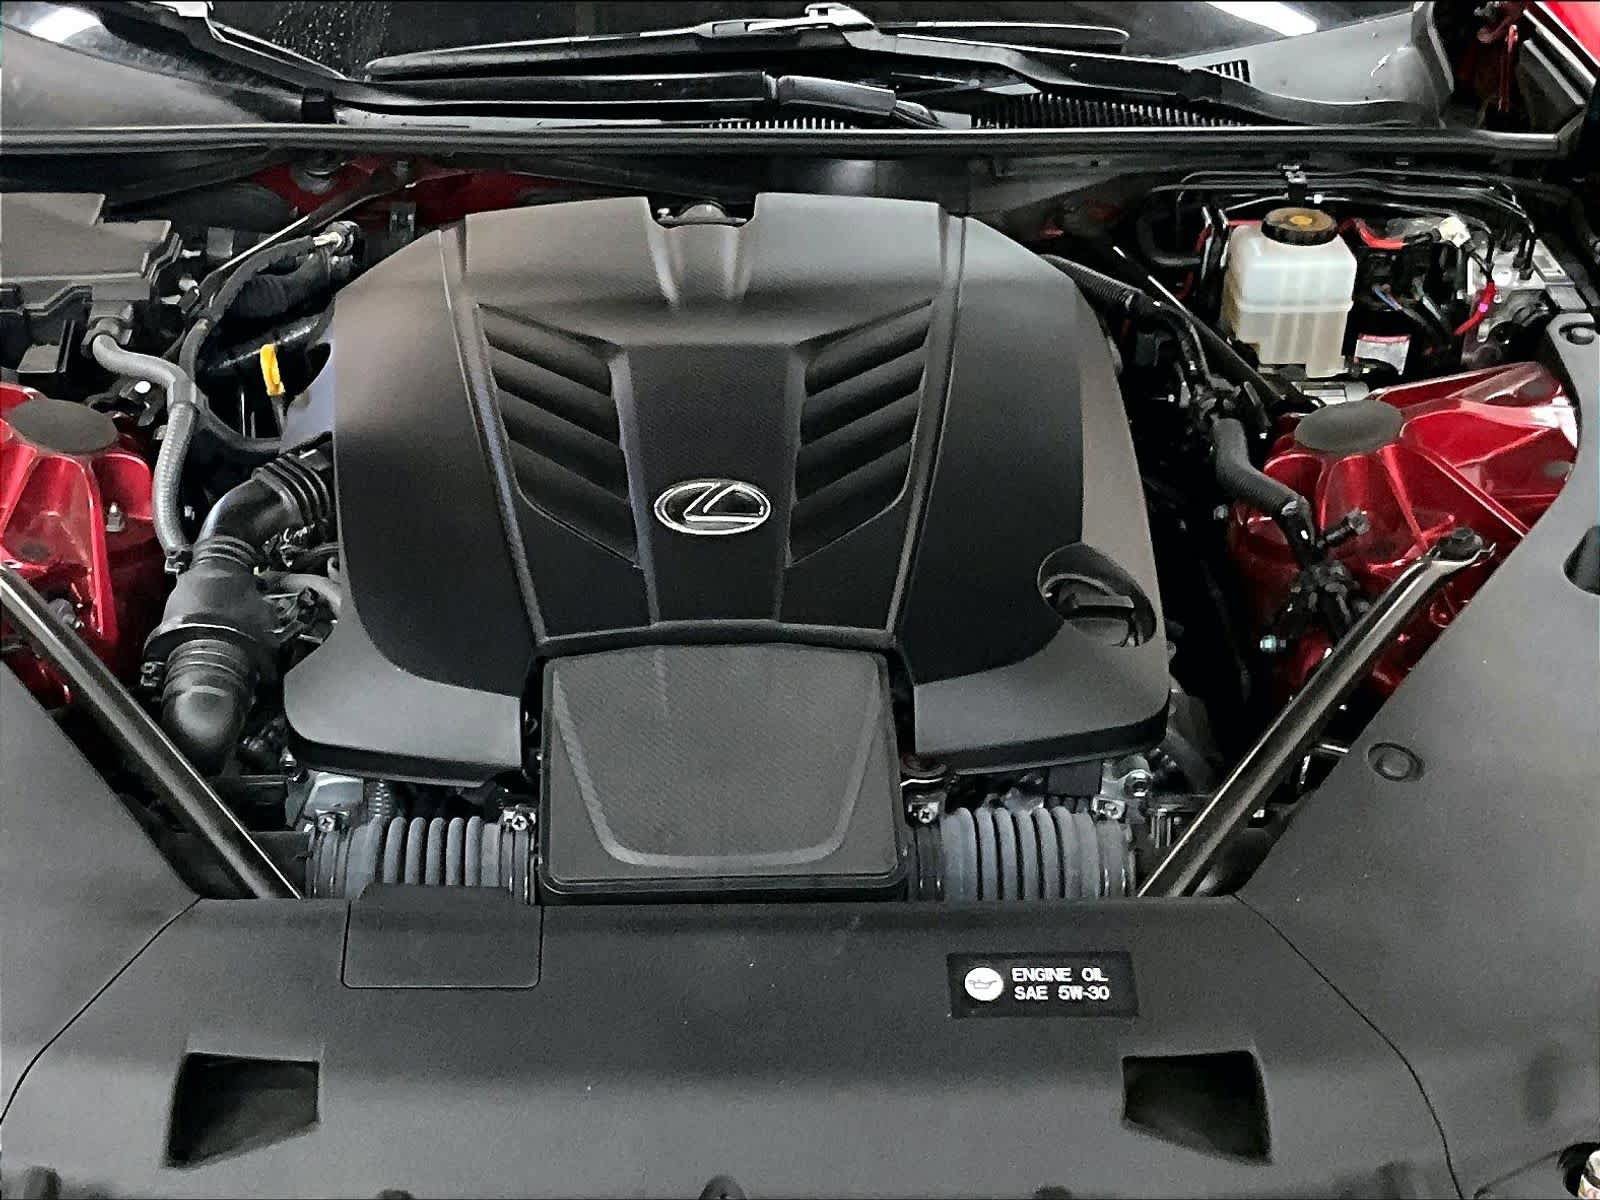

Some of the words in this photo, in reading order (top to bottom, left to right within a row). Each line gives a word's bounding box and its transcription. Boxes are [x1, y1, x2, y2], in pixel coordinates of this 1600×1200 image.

[1012, 967, 1072, 982] ENGINE
[1081, 967, 1109, 982] OIL
[1014, 985, 1049, 1000] SAE
[1057, 985, 1110, 1001] 5W-30
